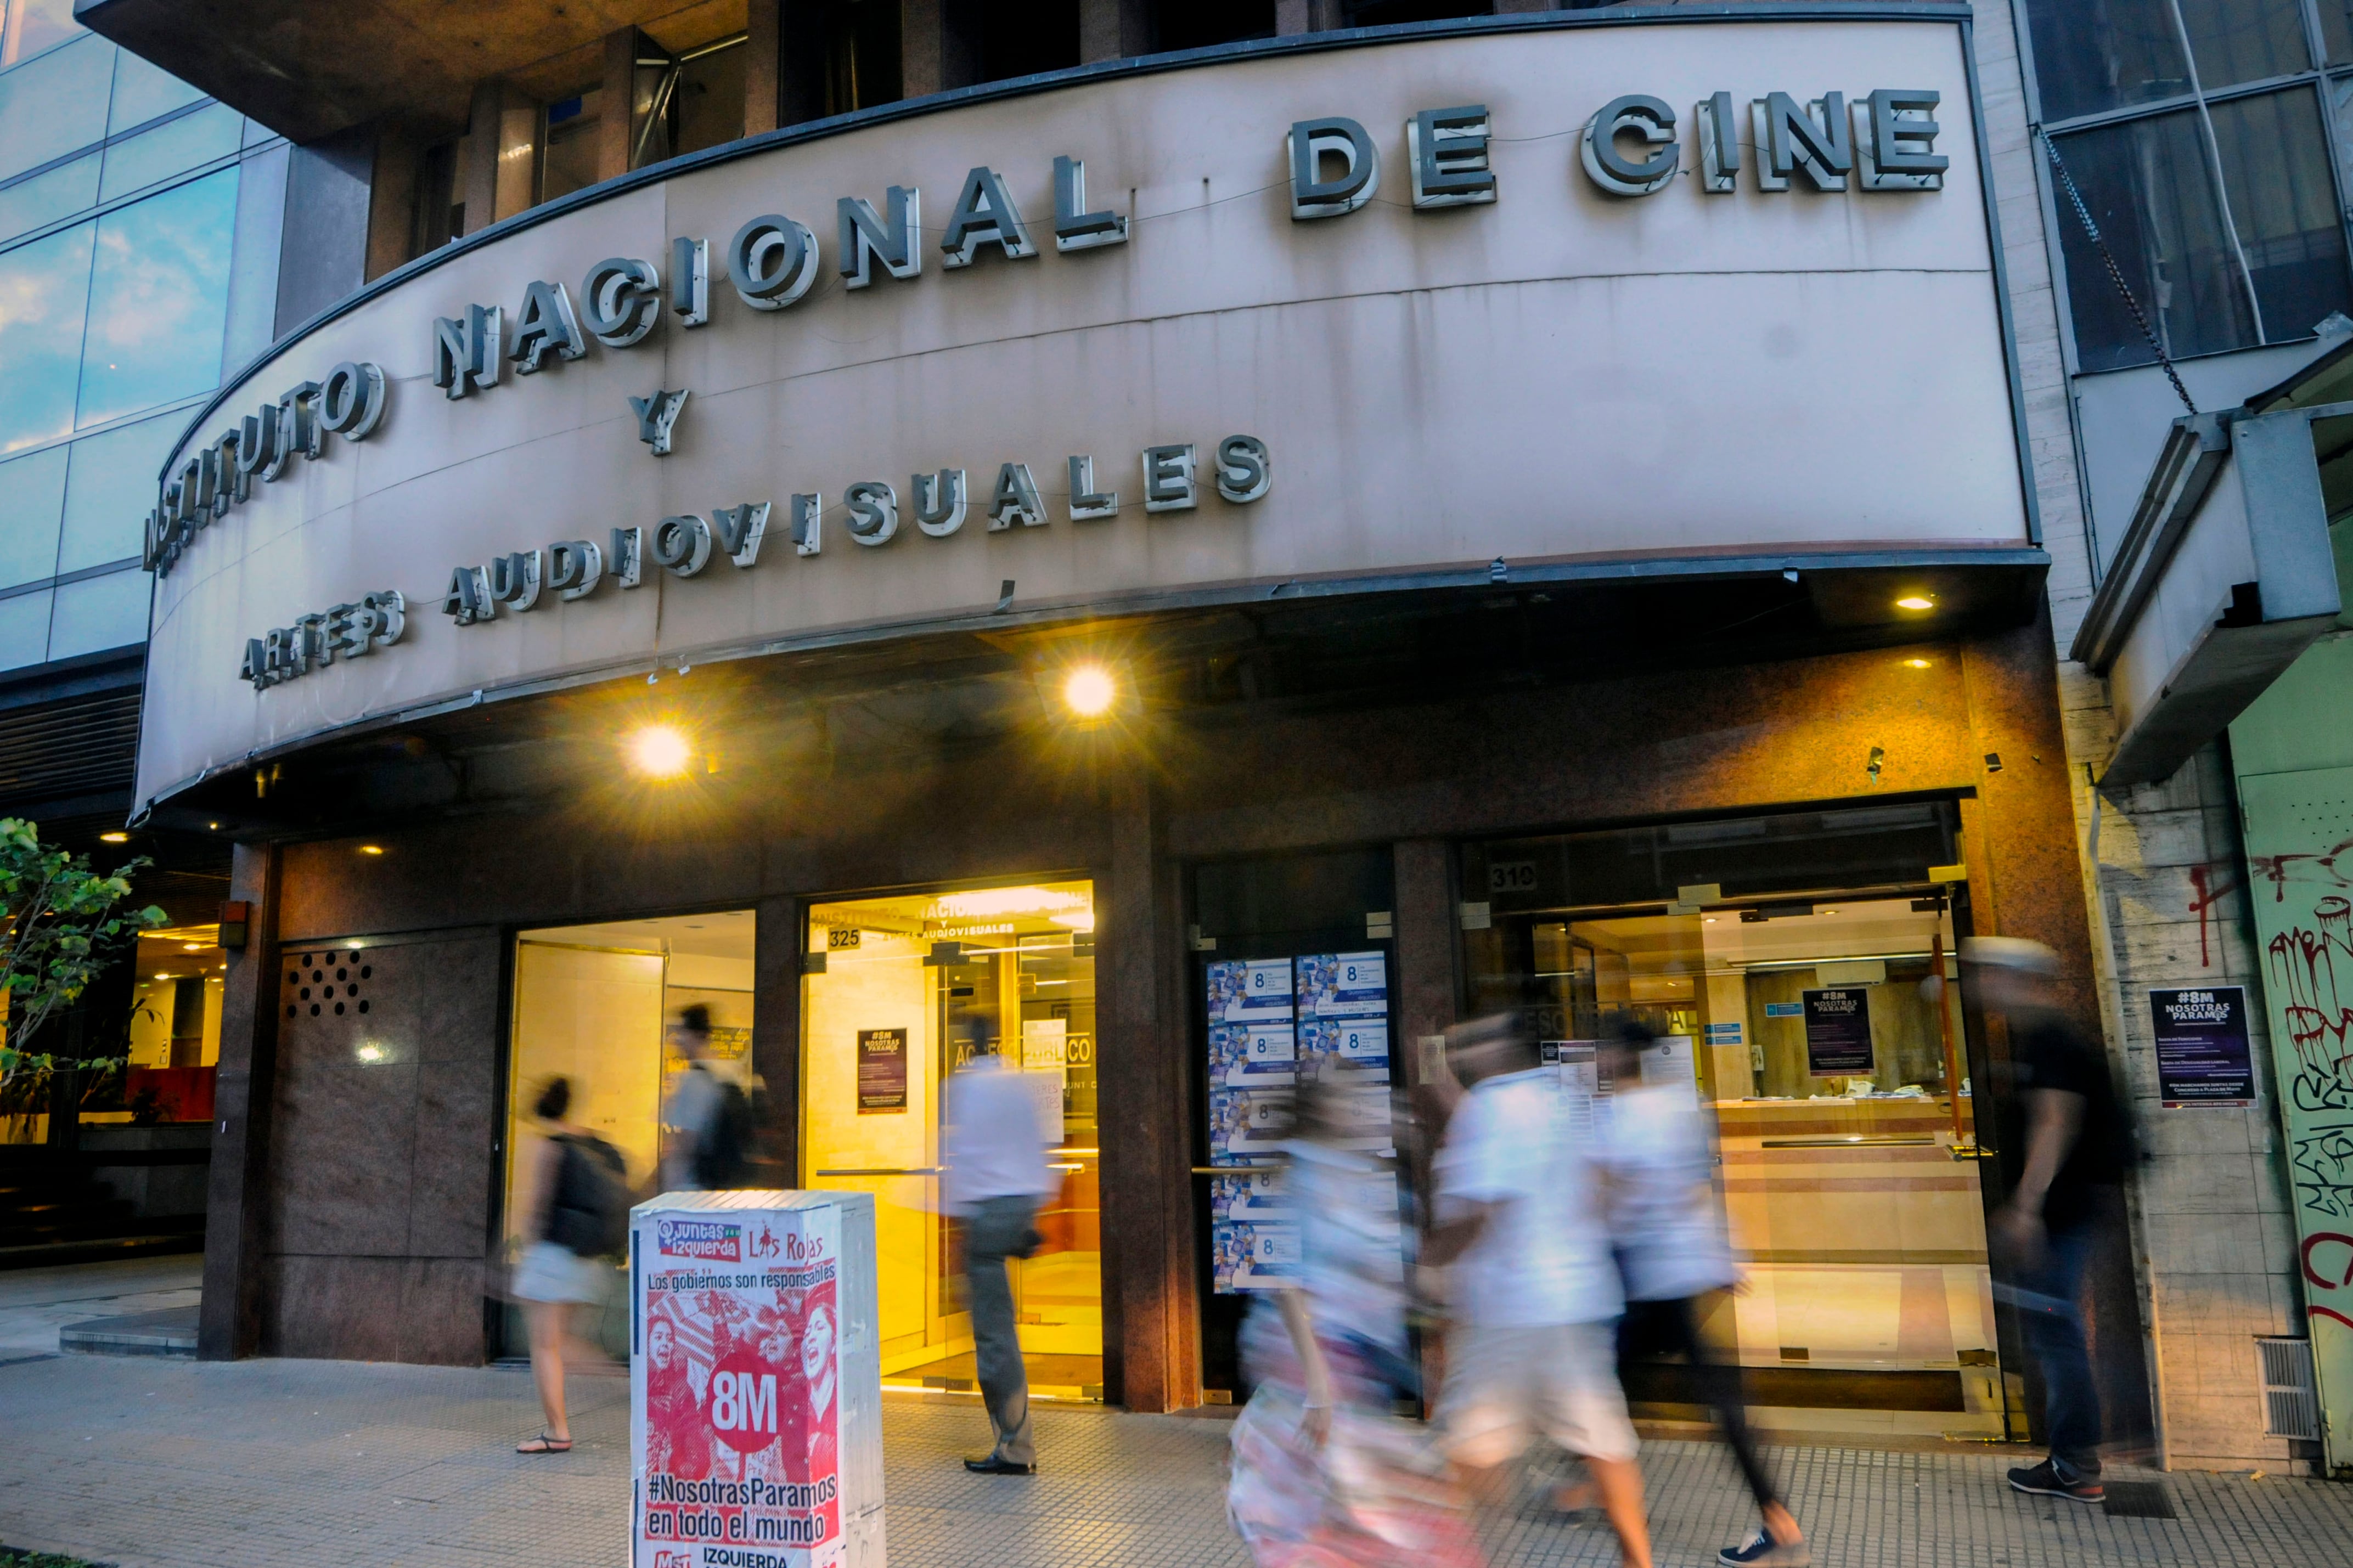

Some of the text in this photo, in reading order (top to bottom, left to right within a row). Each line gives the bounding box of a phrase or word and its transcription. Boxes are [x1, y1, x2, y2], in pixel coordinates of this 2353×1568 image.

[142, 88, 1949, 578] NSTITUTO NACIONAL DE CINE
[627, 389, 689, 456] Y
[238, 433, 1271, 690] ARTES AUDIOVISUALES
[830, 929, 859, 947] 325
[922, 923, 1014, 939] AUDIOVISUALES
[1255, 973, 1264, 988] 8
[1348, 966, 1357, 981] 8
[2177, 991, 2214, 1003] #8M
[2165, 1003, 2230, 1013] NOSOTRAS
[1257, 1039, 1266, 1053] 8
[1349, 1034, 1359, 1048] 8
[1259, 1104, 1269, 1119] 8
[672, 1237, 736, 1257] izquierda
[1264, 1239, 1274, 1255] 8
[648, 1265, 835, 1293] Los gobiernos son responsables
[712, 1370, 777, 1434] 8M
[649, 1475, 836, 1508] #NosotrasParamos
[649, 1509, 824, 1542] en todo el mundo
[703, 1547, 787, 1568] IZQUIERDA
